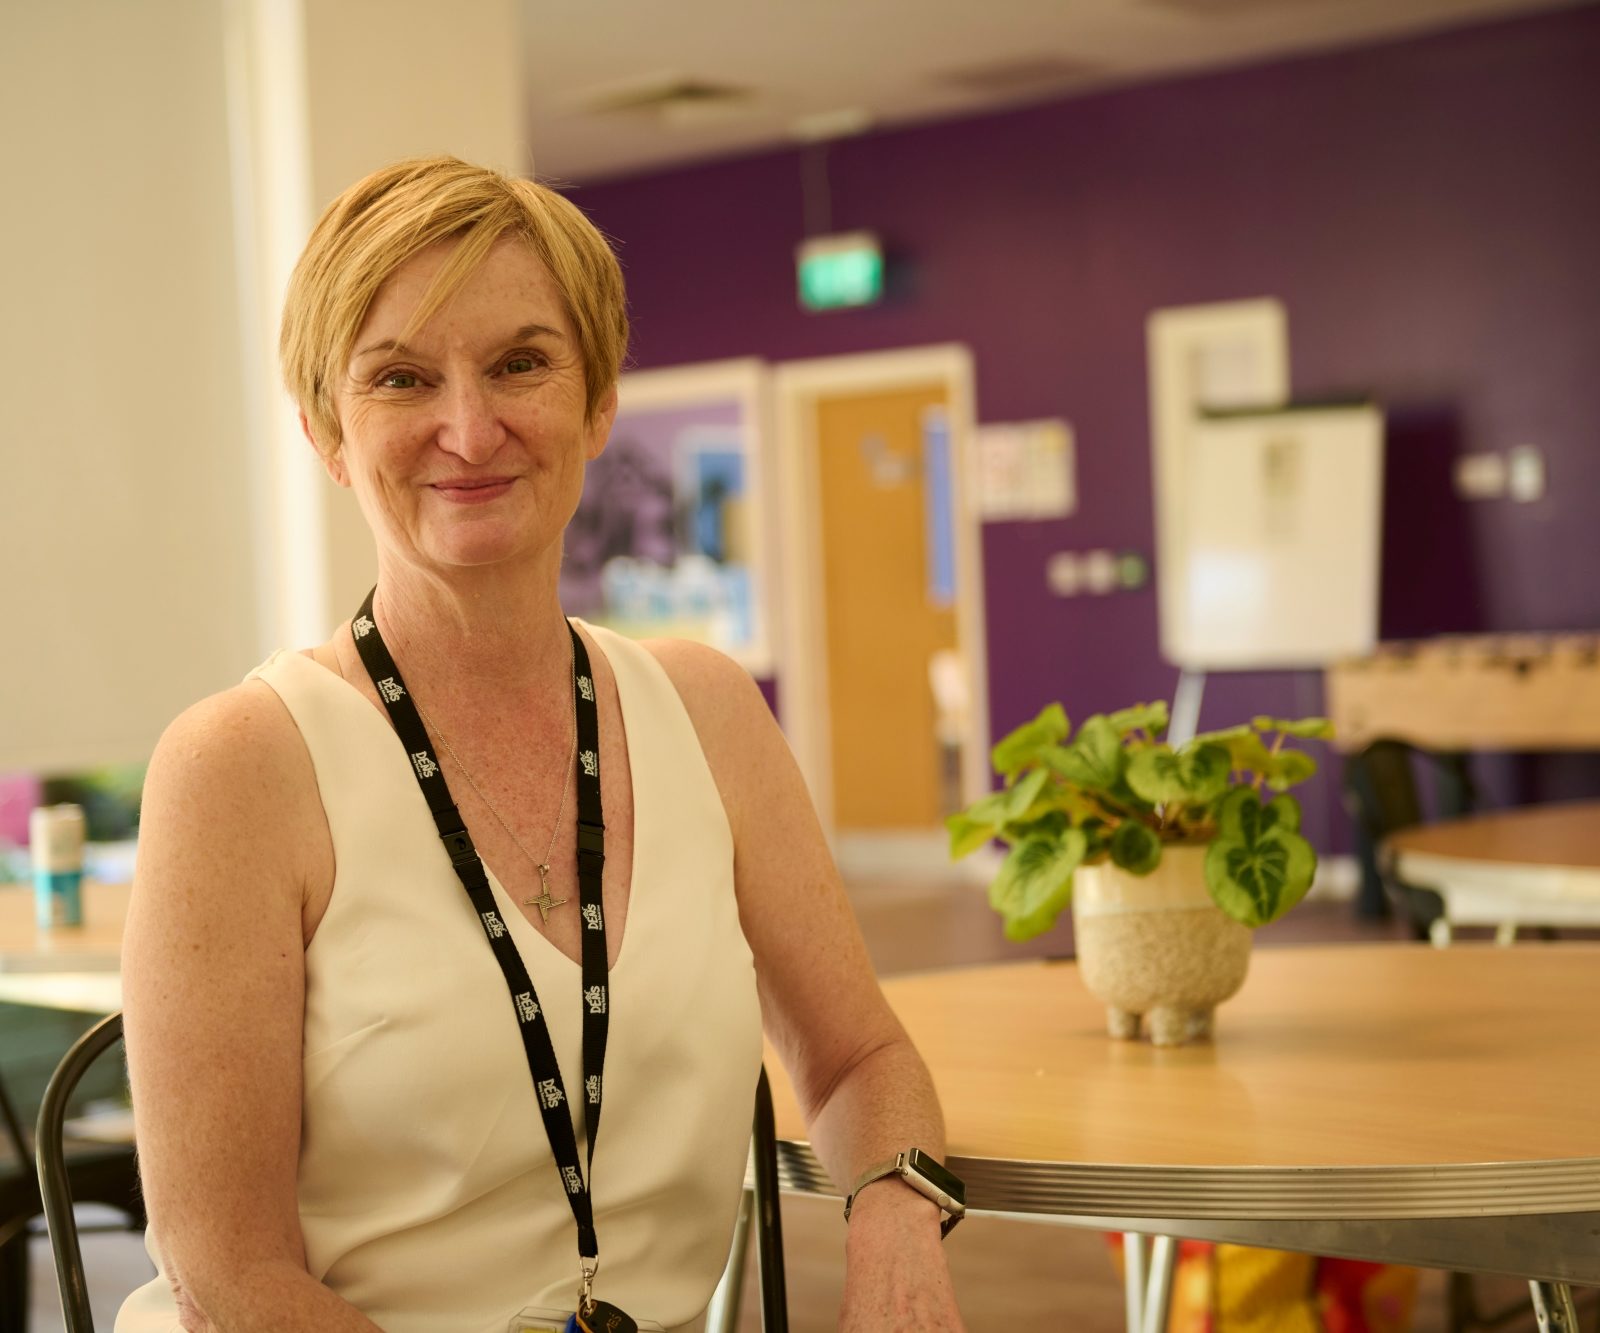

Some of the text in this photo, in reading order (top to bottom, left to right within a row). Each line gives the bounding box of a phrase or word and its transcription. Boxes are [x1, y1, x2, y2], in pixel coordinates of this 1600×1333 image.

[381, 676, 400, 702] DENS
[415, 750, 433, 778] DENS
[584, 750, 594, 775] DENS
[485, 911, 503, 938] DENS
[586, 904, 599, 930] DENS
[519, 991, 536, 1021] DENS
[589, 985, 601, 1014] DENS
[542, 1078, 559, 1108] DENS
[589, 1075, 598, 1104] DENS
[565, 1165, 580, 1194] DENS
